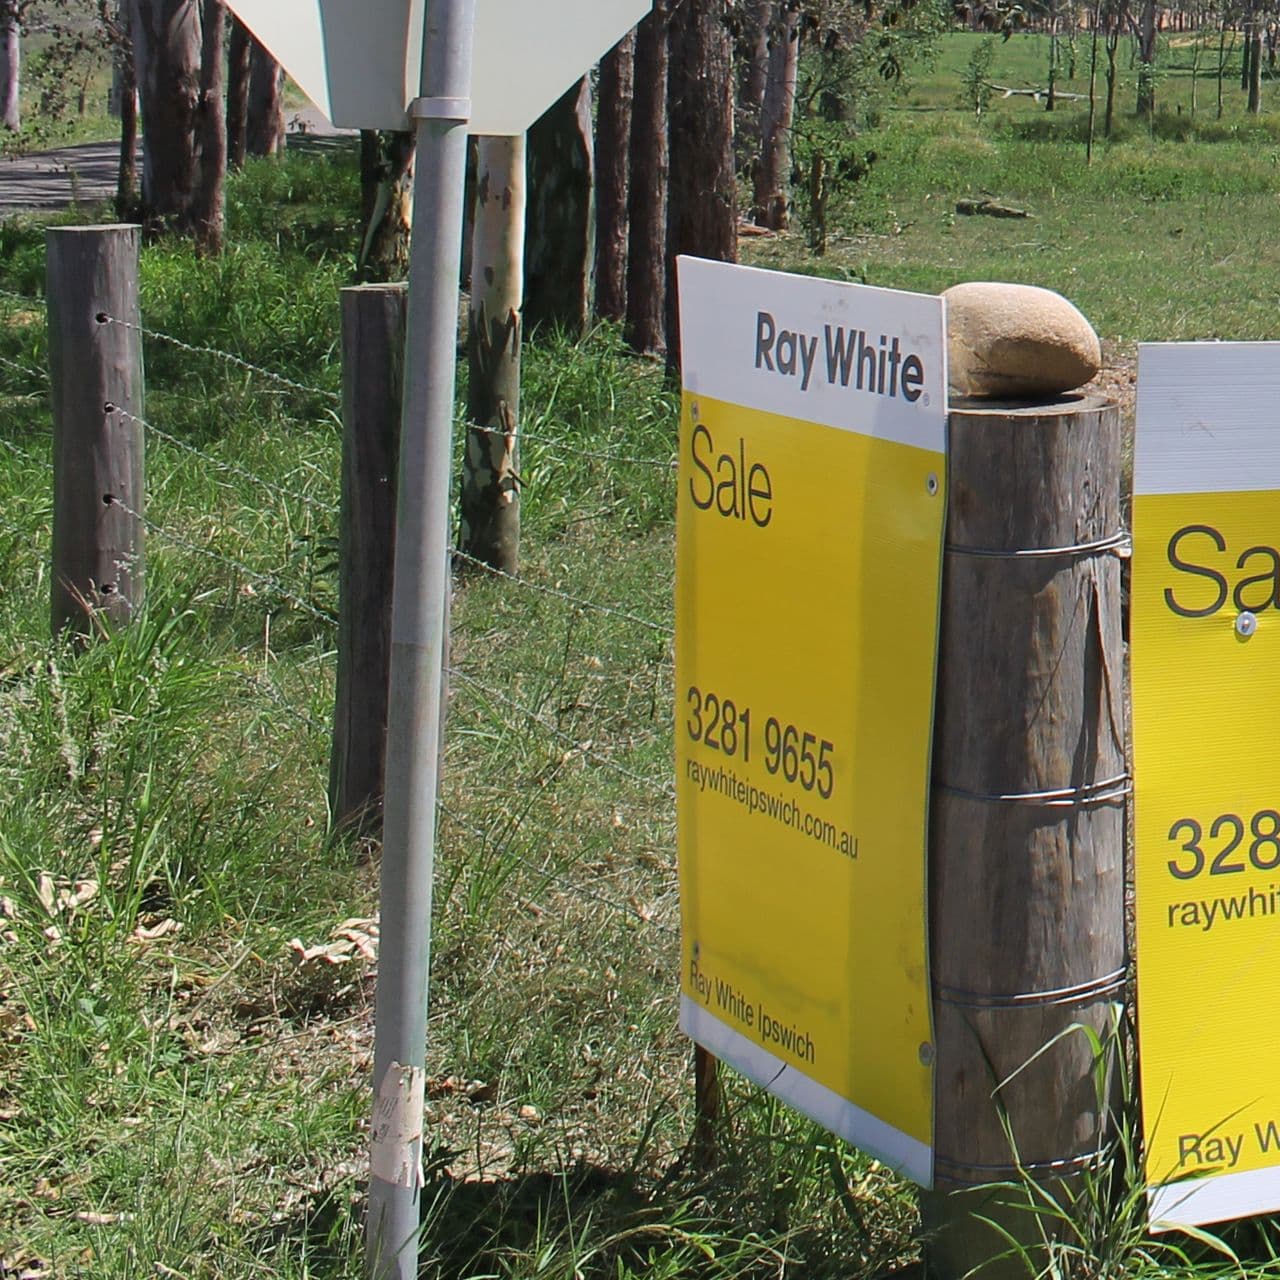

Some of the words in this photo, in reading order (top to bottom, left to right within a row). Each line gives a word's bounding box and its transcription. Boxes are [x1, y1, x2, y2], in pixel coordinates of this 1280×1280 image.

[755, 311, 819, 392] Ray
[824, 324, 926, 403] White
[689, 423, 774, 528] Sale
[687, 686, 751, 763] 3281
[765, 717, 834, 800] 9655
[686, 759, 859, 861] raywhiteipswich.com.au
[690, 959, 713, 1005] Ray
[715, 977, 755, 1026] White
[758, 1004, 815, 1065] Ipswich
[1178, 1133, 1244, 1168] Ray
